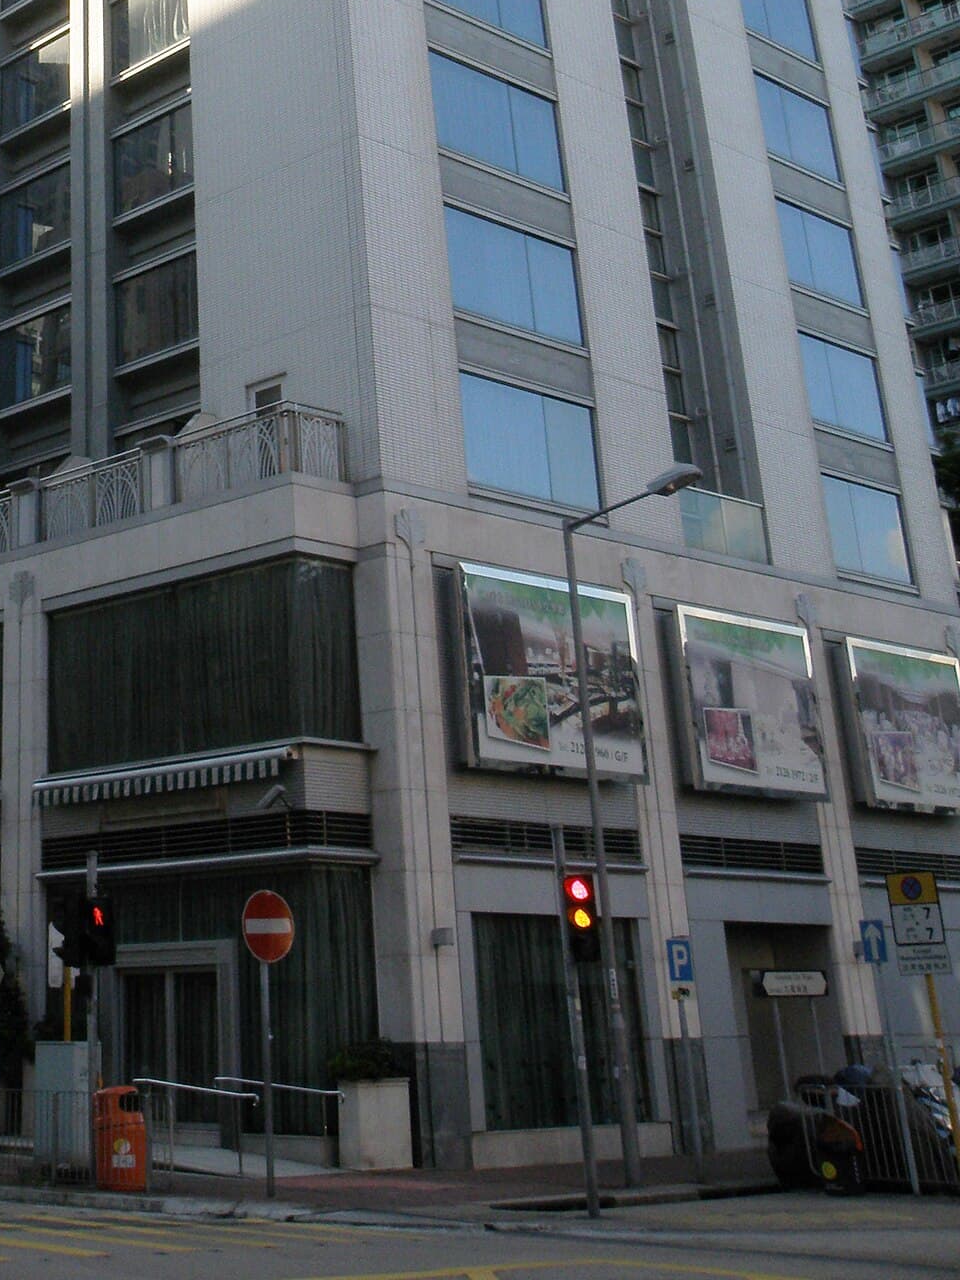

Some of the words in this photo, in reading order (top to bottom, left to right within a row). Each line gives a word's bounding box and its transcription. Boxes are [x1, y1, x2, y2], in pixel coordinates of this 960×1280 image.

[922, 907, 930, 920] 7
[926, 928, 934, 940] 7
[672, 944, 688, 978] P
